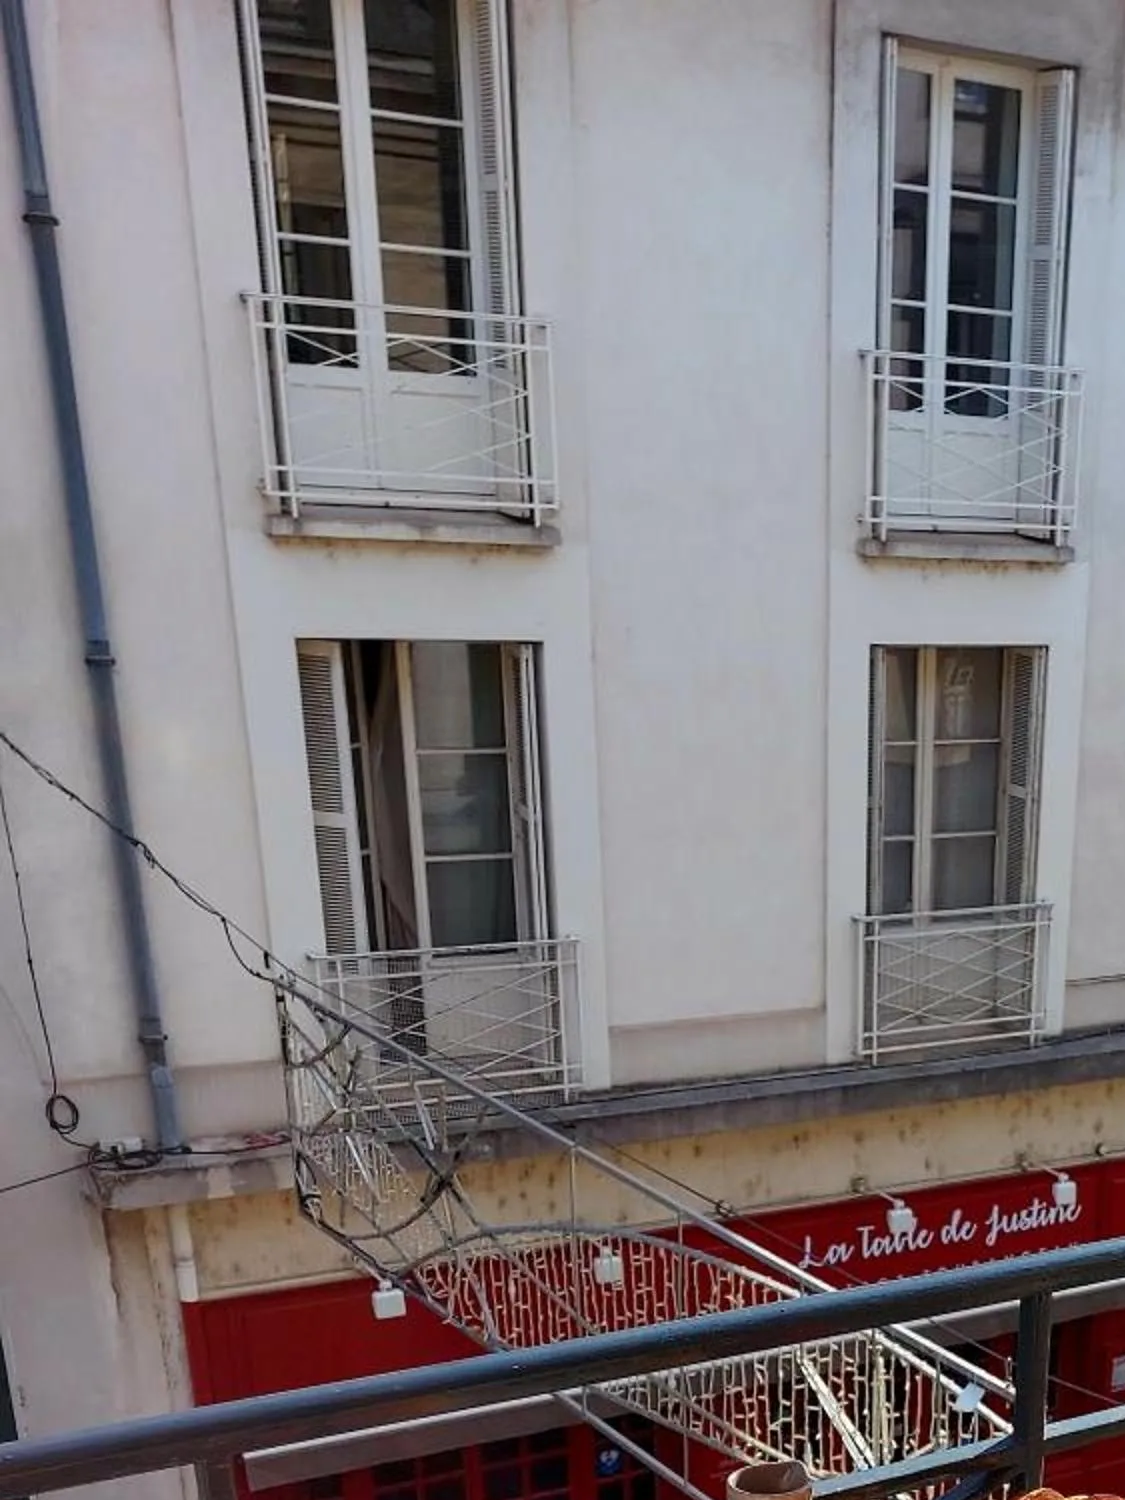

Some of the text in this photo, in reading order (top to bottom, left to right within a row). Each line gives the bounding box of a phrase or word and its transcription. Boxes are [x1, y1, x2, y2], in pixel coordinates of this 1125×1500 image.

[799, 1235, 854, 1269] La
[940, 1208, 977, 1244] de
[985, 1197, 1082, 1246] Justine
